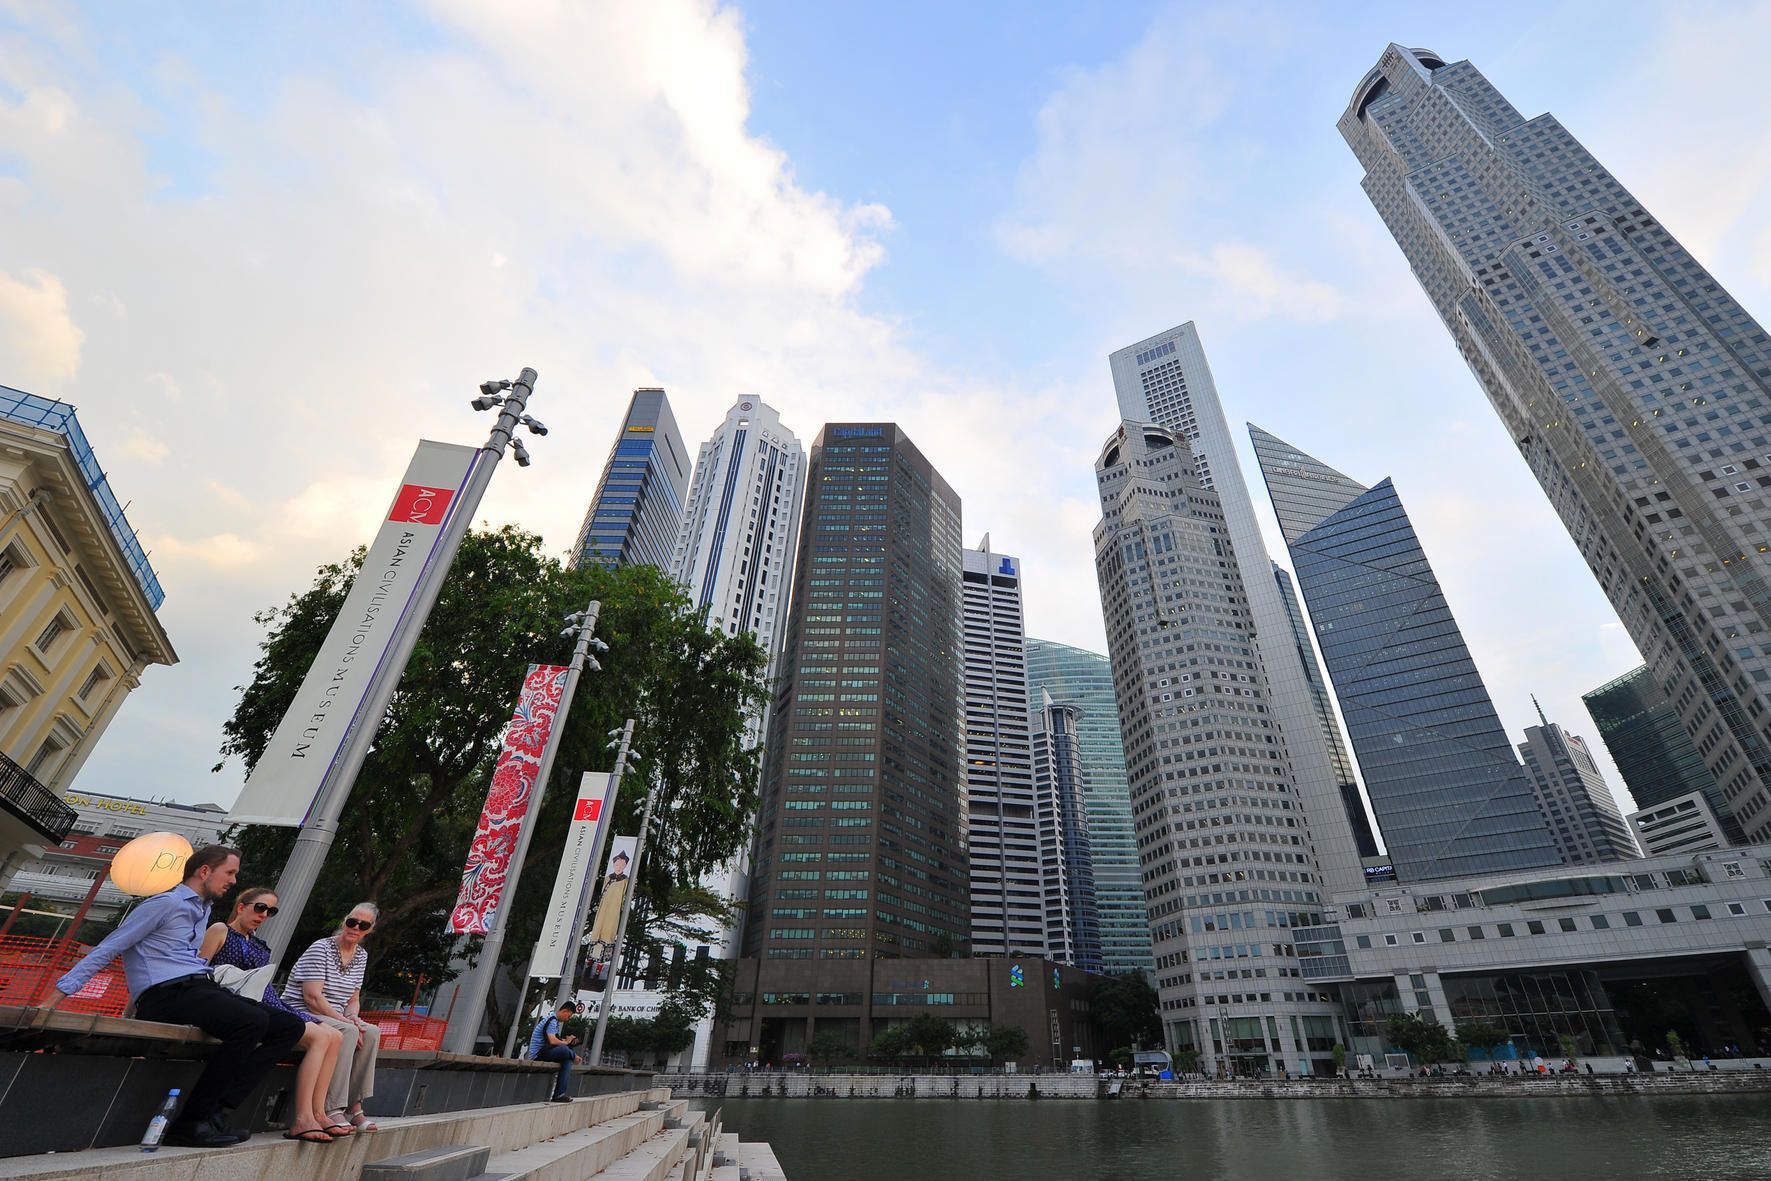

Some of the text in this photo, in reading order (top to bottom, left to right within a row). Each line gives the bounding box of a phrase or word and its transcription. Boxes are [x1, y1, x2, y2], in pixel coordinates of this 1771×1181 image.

[407, 488, 436, 524] ACM
[290, 531, 414, 759] ASIAN CIVILISATIONS MUSEUM
[96, 799, 146, 815] HOTEL
[582, 800, 595, 821] ACM
[549, 825, 587, 948] ASIAN CIVILISATIONS MUSEUM
